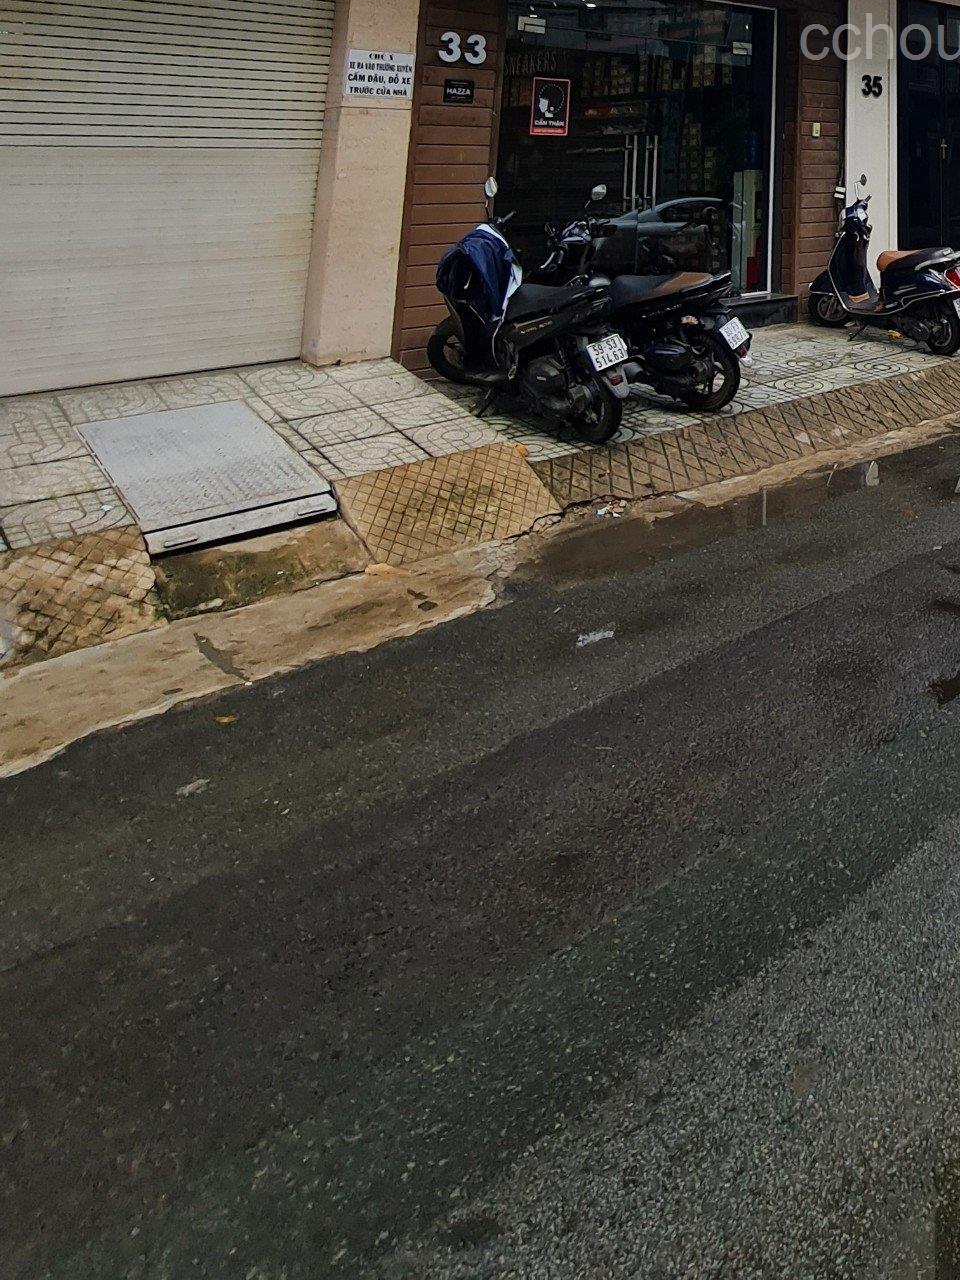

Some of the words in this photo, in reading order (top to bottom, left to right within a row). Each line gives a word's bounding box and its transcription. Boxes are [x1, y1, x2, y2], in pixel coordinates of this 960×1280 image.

[438, 31, 487, 65] 33
[401, 77, 411, 85] XE
[861, 74, 883, 99] 35
[592, 338, 618, 356] 59-S3
